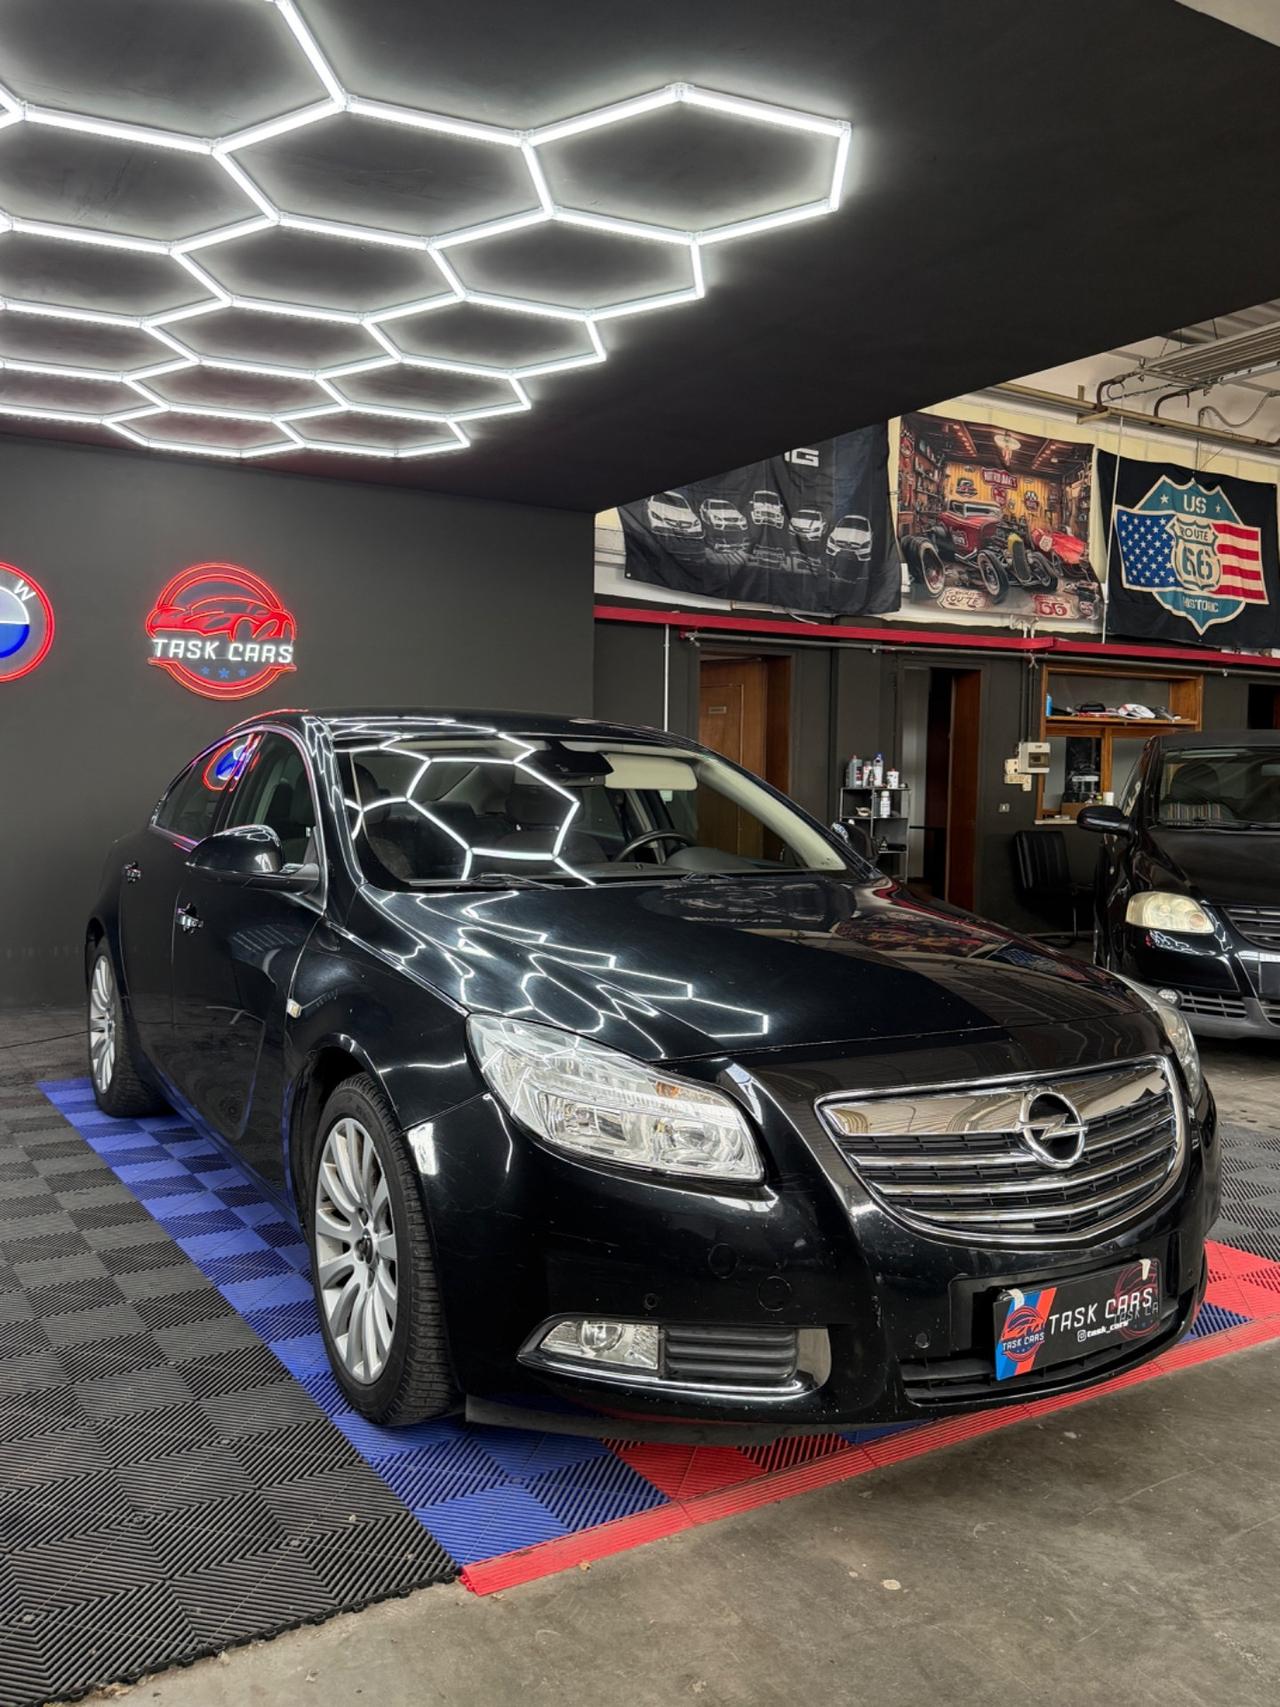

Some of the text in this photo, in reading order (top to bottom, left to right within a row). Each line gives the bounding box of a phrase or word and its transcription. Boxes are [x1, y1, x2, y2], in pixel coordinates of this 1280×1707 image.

[1183, 494, 1207, 514] US
[1180, 525, 1209, 542] ROUTE
[1181, 545, 1213, 580] 66
[1039, 601, 1067, 616] 66
[153, 638, 294, 664] TASK CARS
[1048, 1287, 1153, 1335] TASK CARS
[1087, 1319, 1129, 1338] task_cars
[1002, 1331, 1045, 1351] TASK CARS
